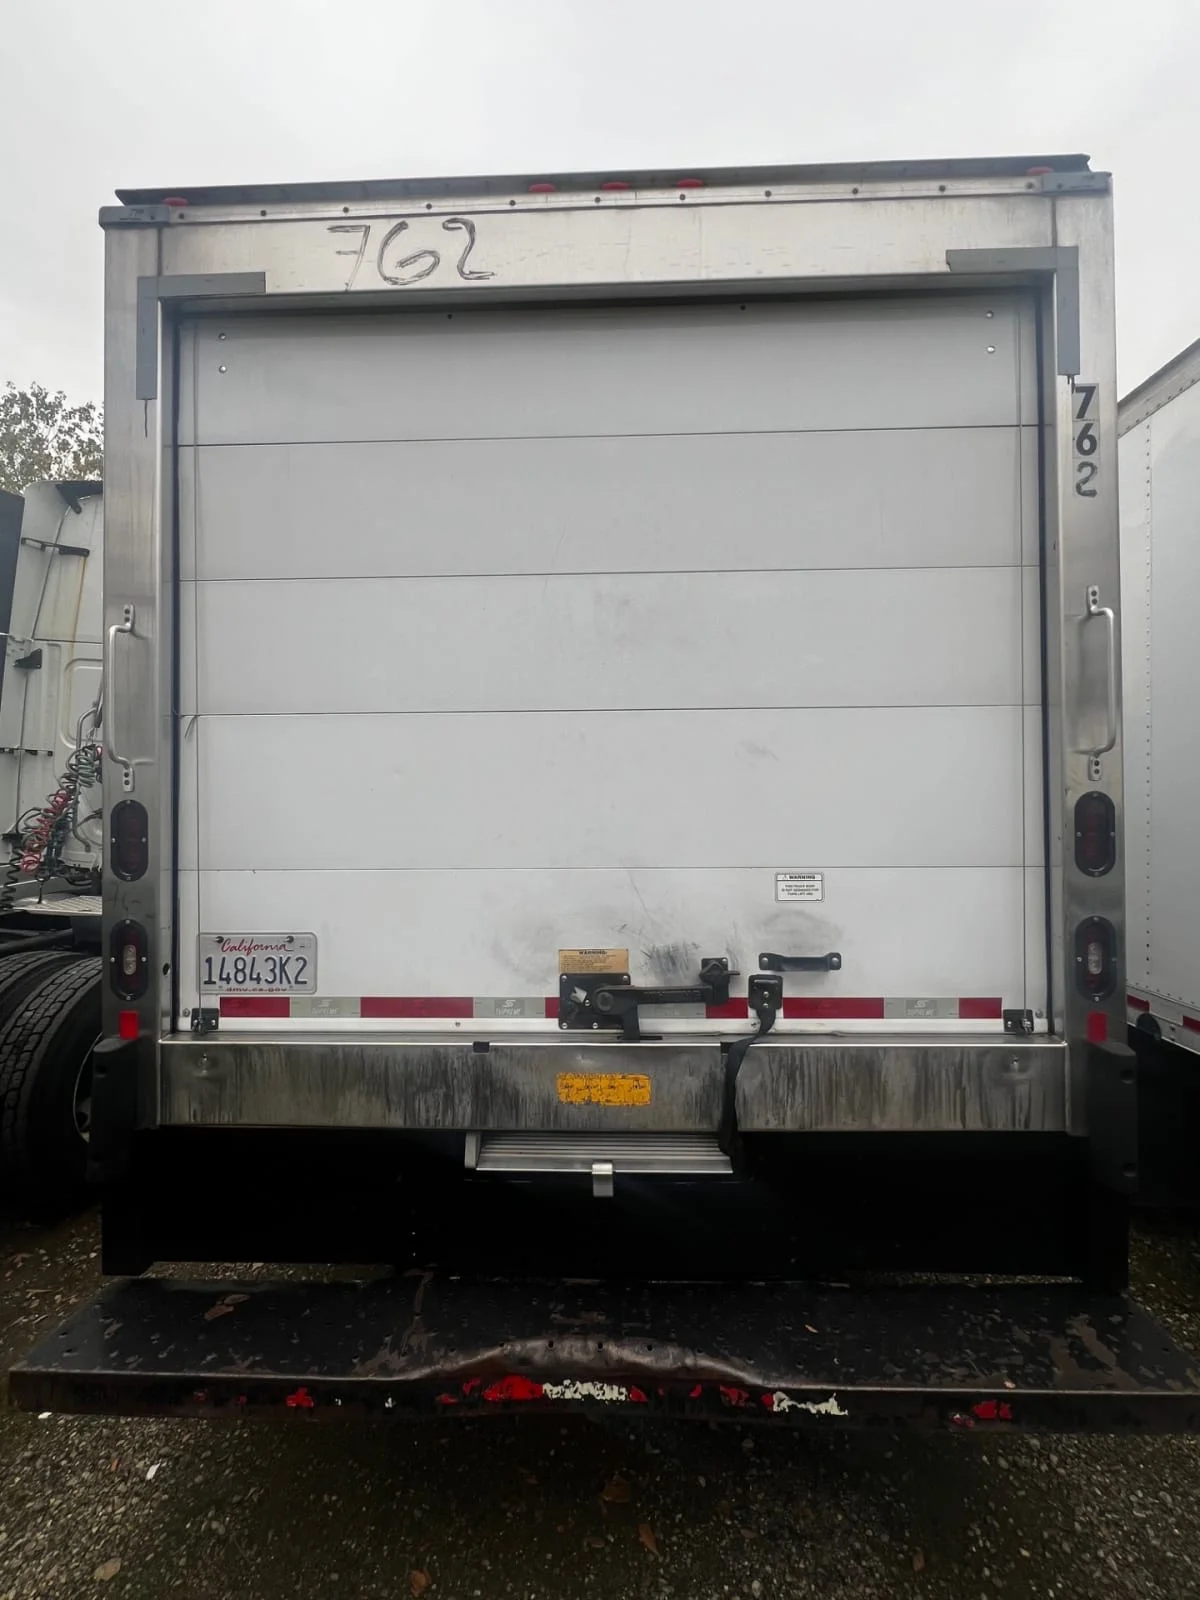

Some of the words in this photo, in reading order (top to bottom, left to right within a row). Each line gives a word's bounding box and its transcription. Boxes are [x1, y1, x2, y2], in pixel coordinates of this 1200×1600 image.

[326, 217, 496, 292] 762
[1075, 385, 1098, 498] 762
[203, 956, 308, 985] 14843K2
[221, 938, 295, 955] California
